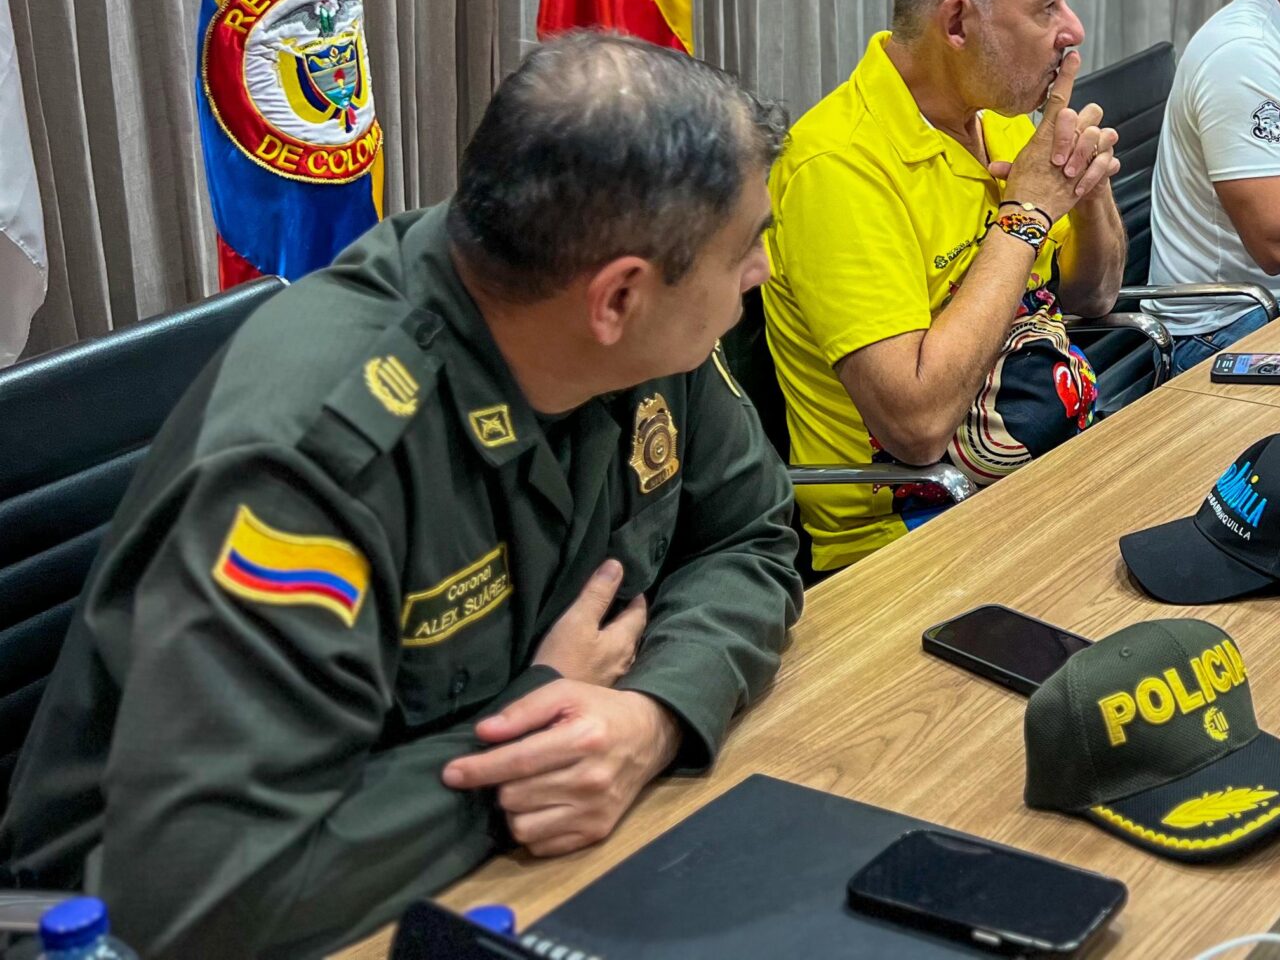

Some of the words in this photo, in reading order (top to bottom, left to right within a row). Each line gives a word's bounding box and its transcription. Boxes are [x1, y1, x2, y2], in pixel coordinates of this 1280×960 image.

[256, 134, 304, 170] DE
[447, 565, 492, 601] Coronel
[414, 607, 459, 637] ALEX
